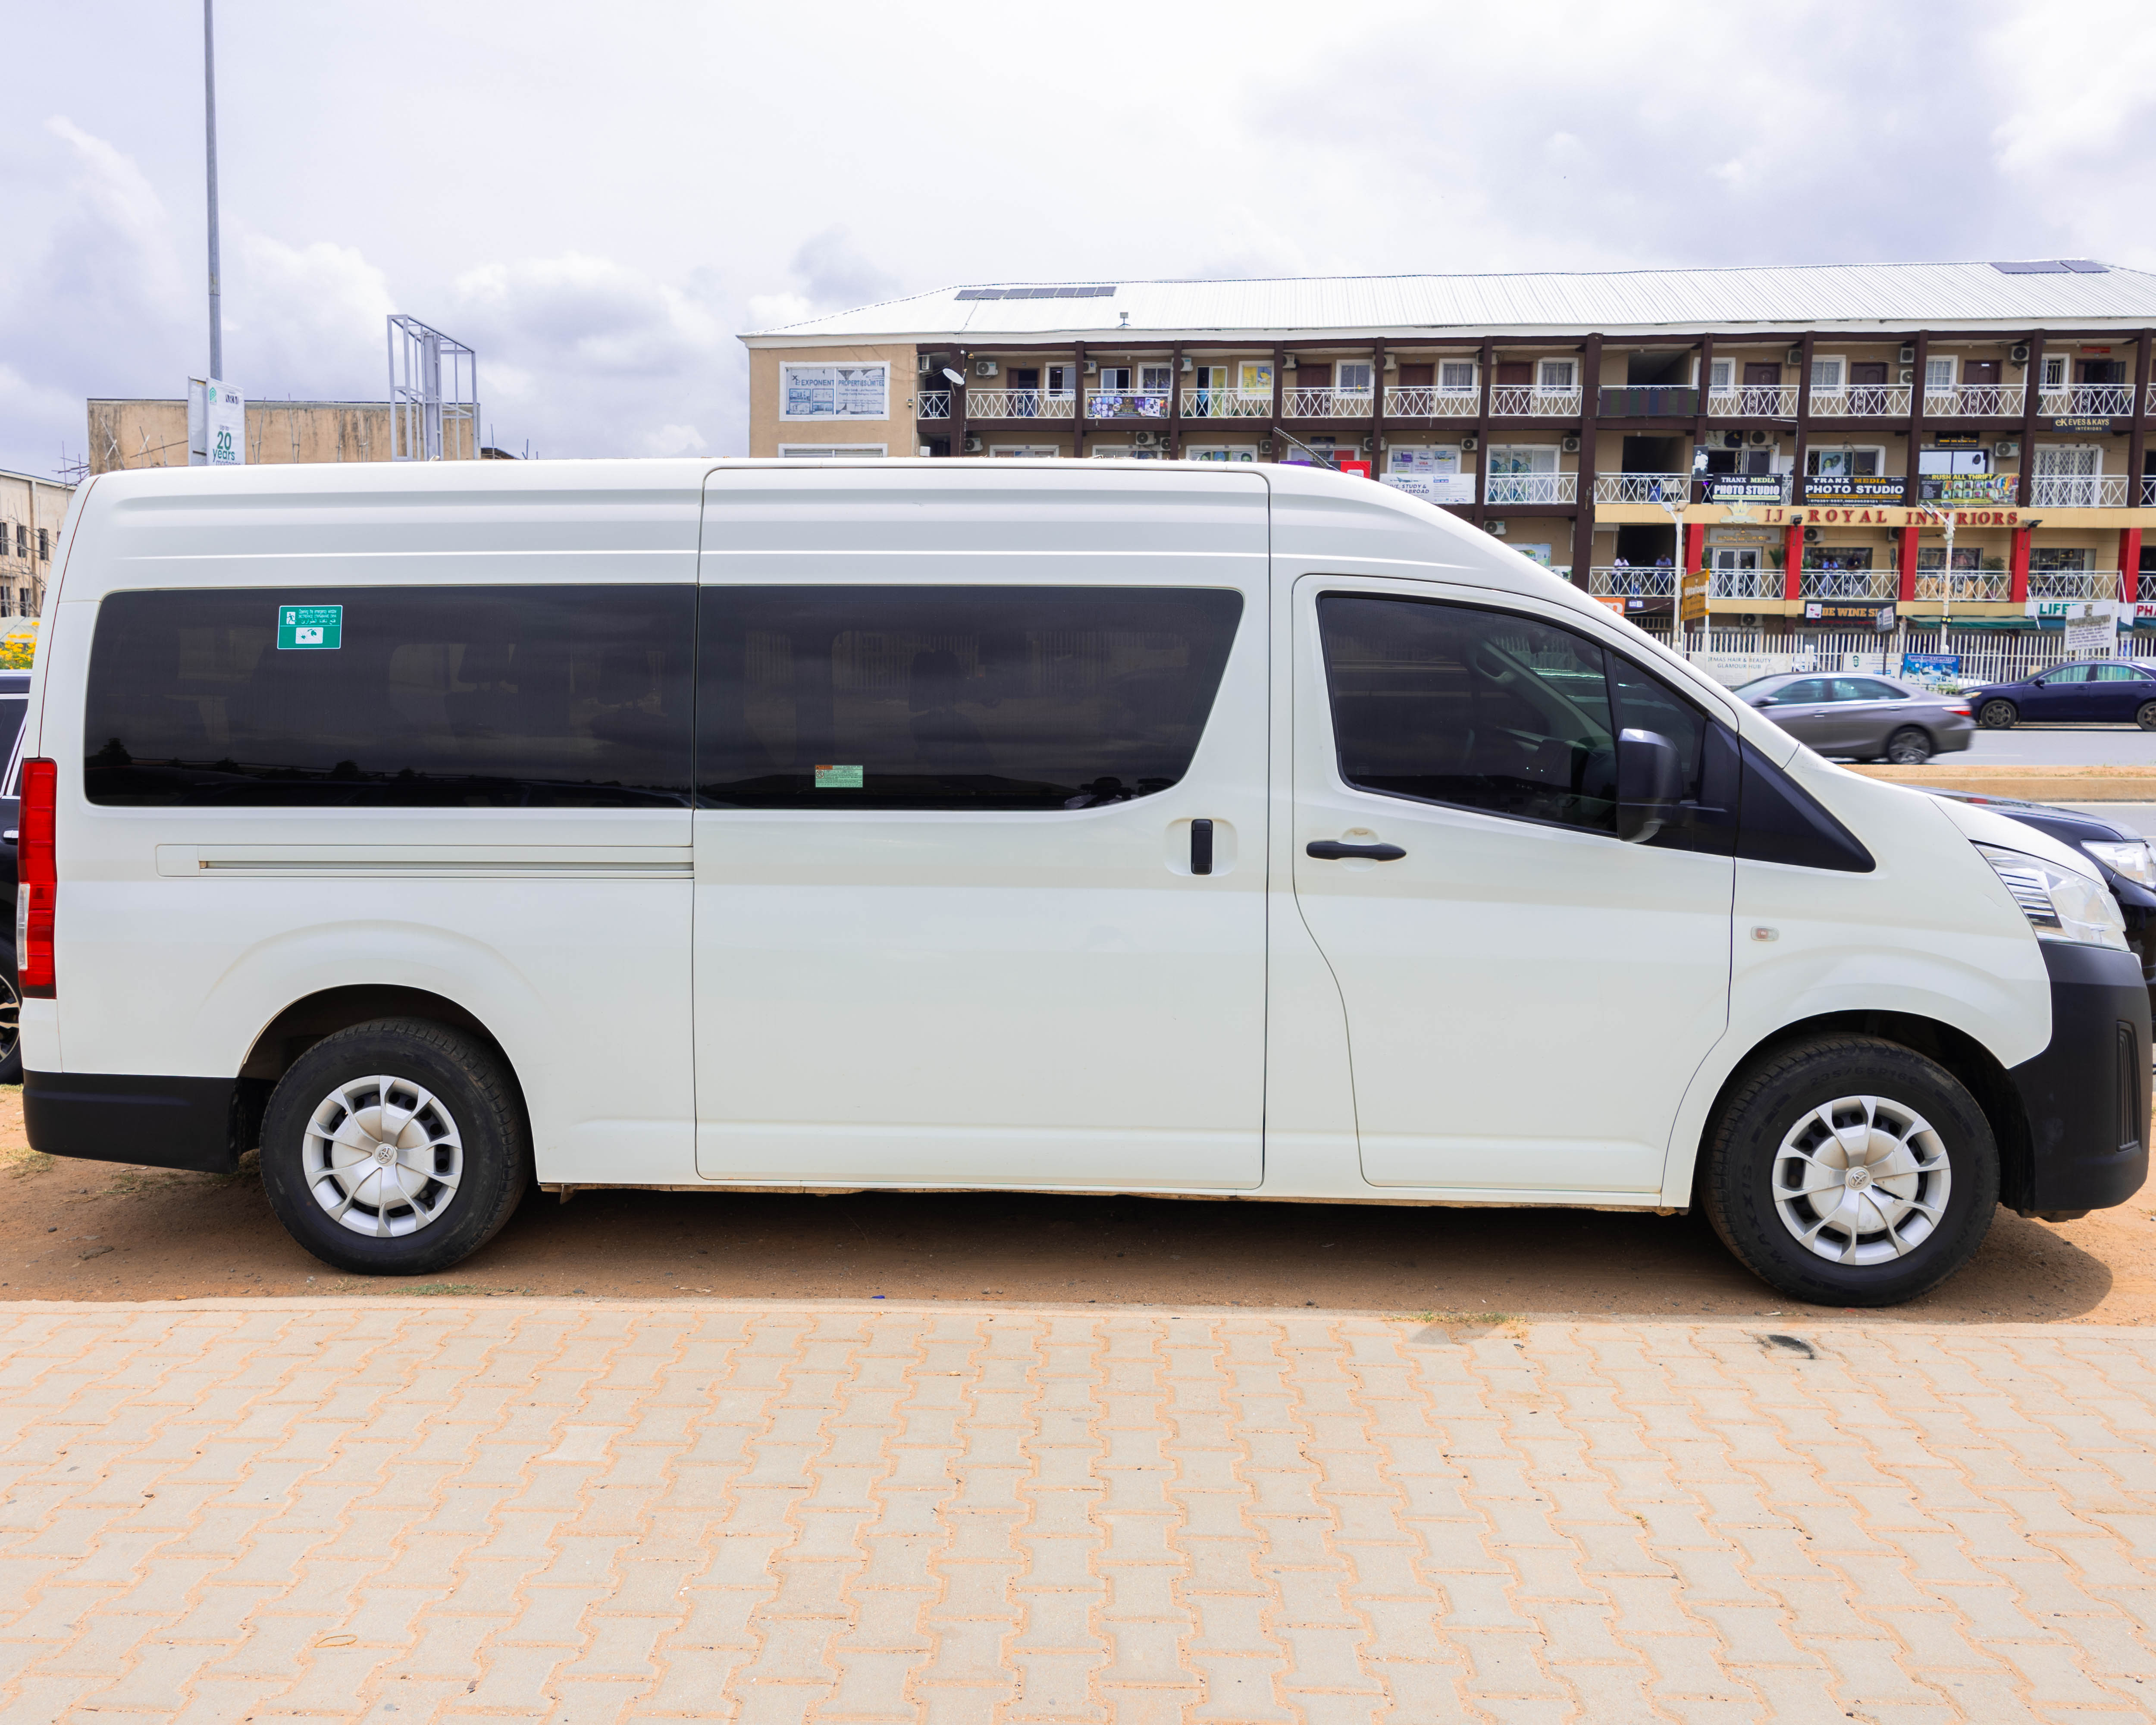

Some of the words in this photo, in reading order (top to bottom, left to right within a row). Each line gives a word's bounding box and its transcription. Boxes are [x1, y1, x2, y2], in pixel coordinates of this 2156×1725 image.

[217, 431, 231, 450] 20
[213, 448, 235, 462] years
[1714, 485, 1744, 495] PHOTO
[1746, 485, 1780, 495] STUDIO
[1805, 485, 1851, 494] PHOTO
[1856, 485, 1904, 494] STUDIO
[1808, 509, 1887, 523] ROYAL
[1822, 607, 1835, 616] DE
[1837, 608, 1867, 617] WINE
[1742, 1162, 1789, 1264] MAXXIS
